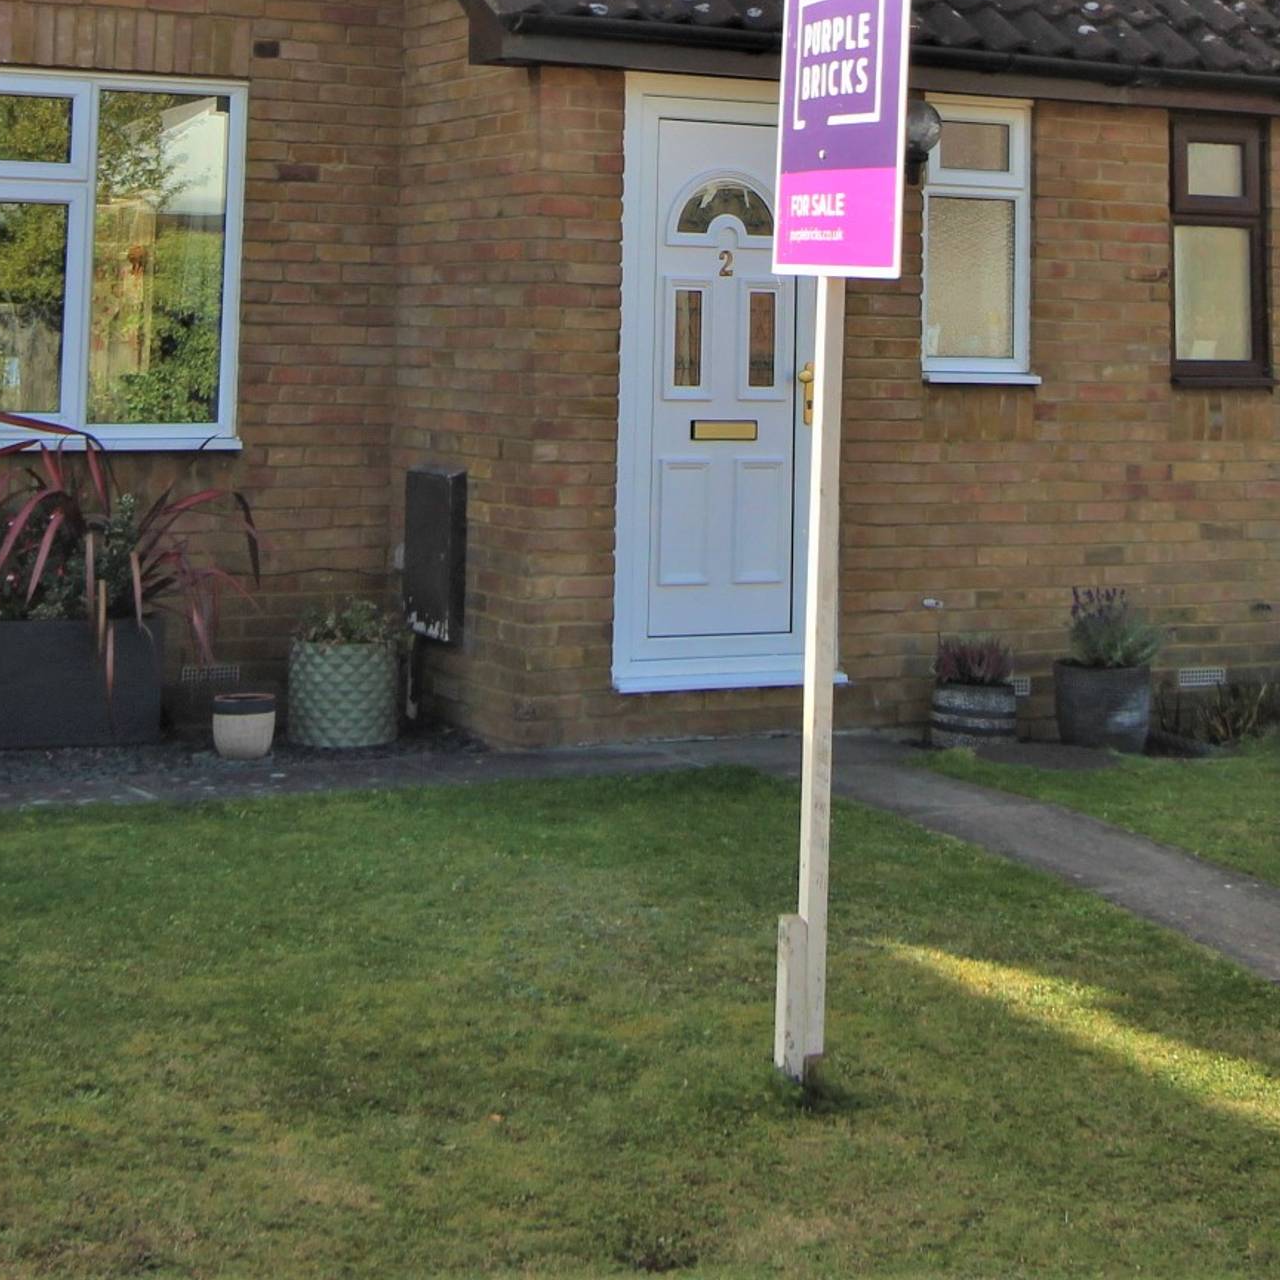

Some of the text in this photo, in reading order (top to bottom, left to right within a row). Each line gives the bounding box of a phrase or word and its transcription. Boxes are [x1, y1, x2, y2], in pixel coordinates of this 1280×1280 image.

[804, 13, 870, 57] PURPLE
[801, 58, 868, 101] BRICKS
[791, 192, 845, 217] FOR SALE
[719, 250, 733, 277] 2
